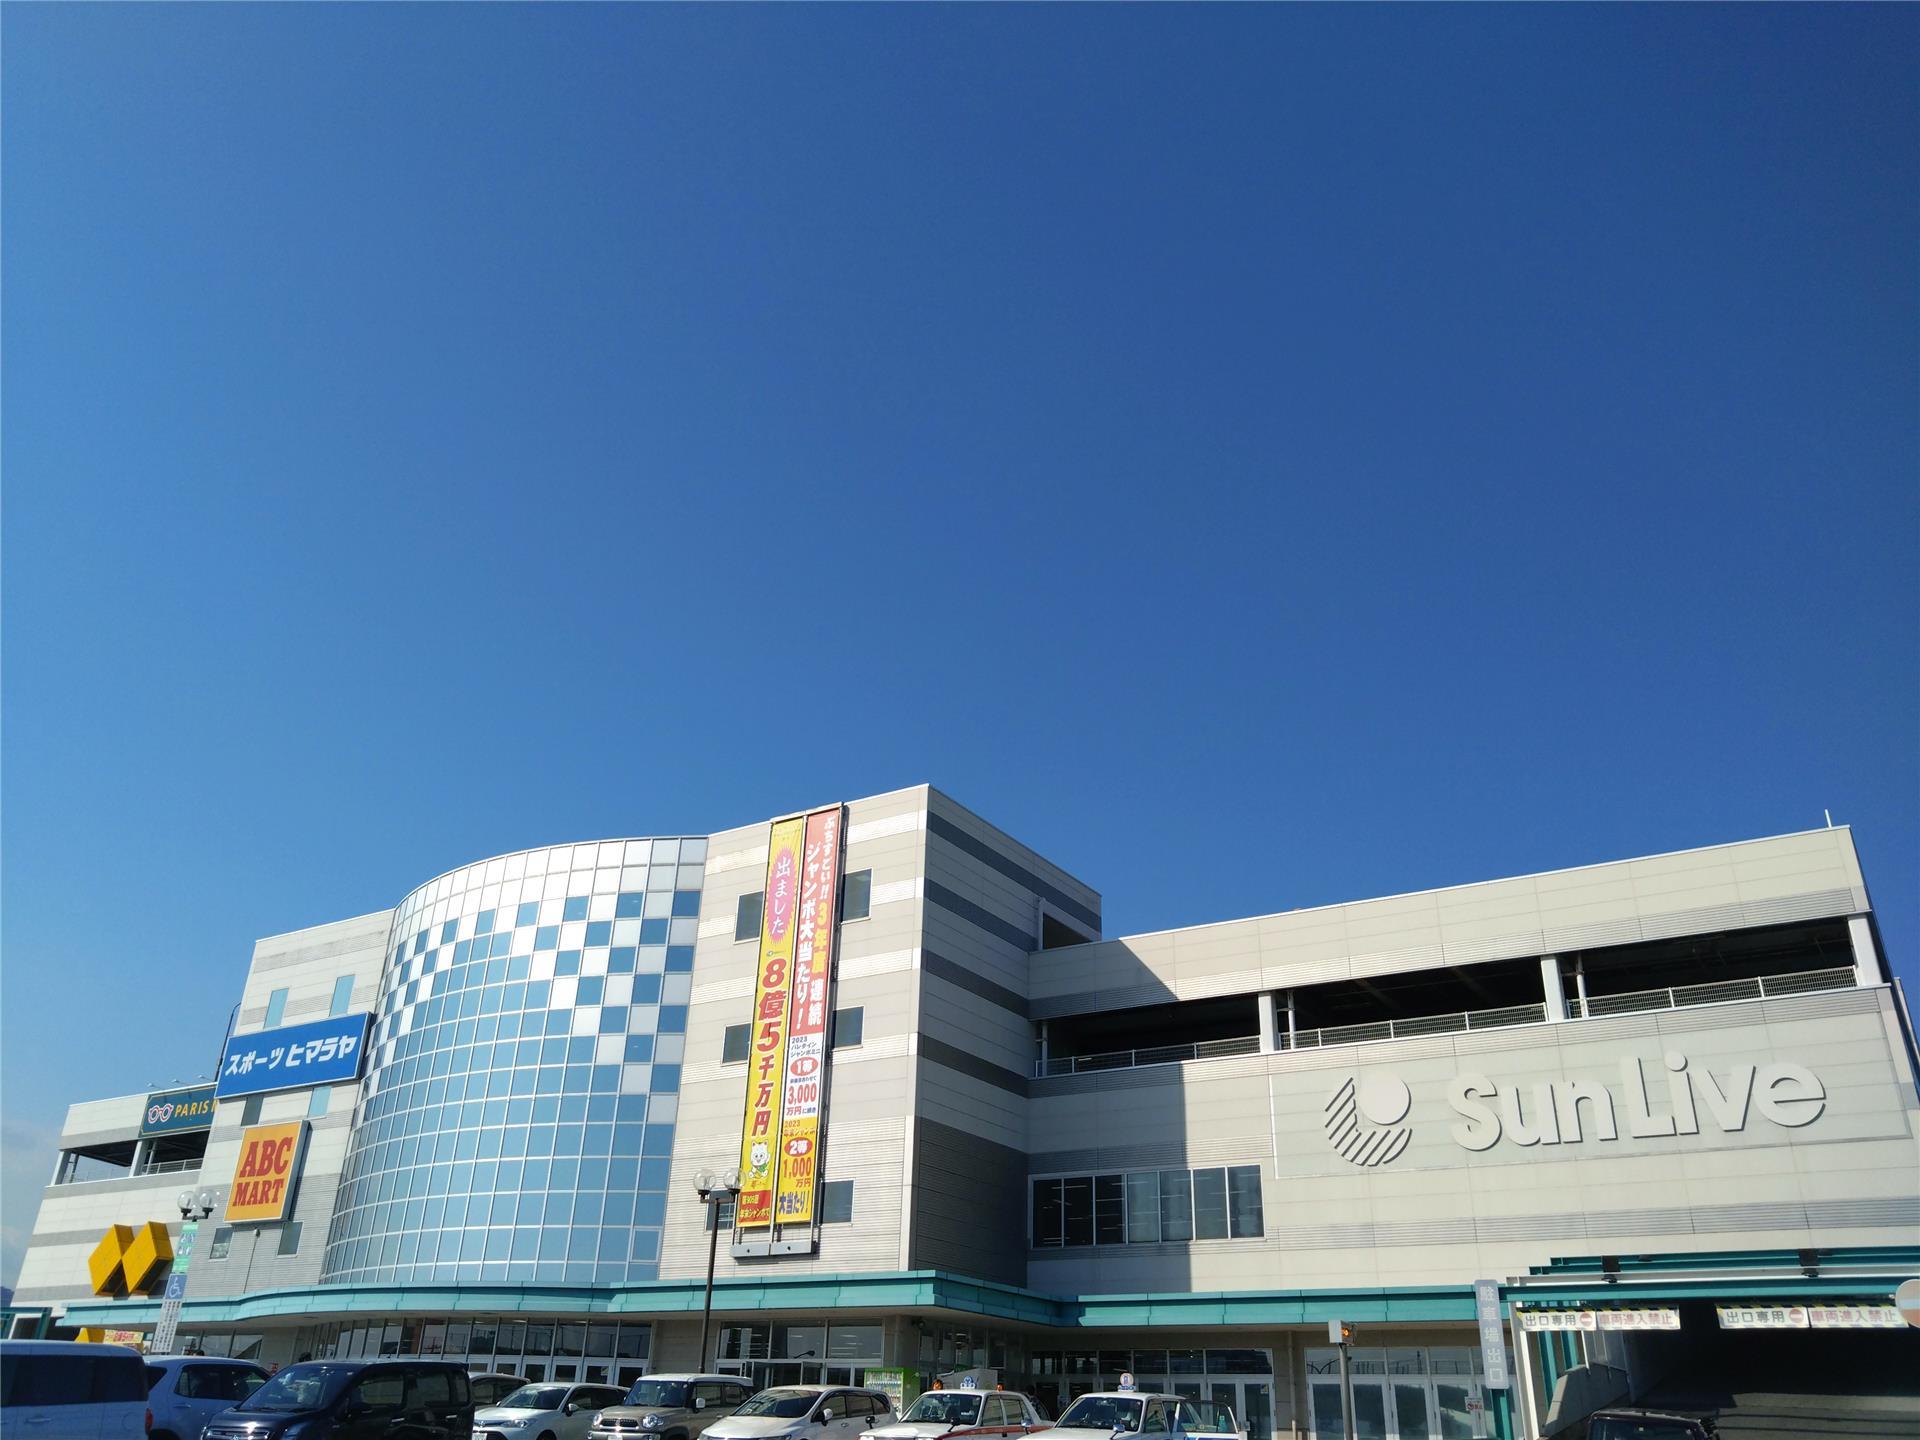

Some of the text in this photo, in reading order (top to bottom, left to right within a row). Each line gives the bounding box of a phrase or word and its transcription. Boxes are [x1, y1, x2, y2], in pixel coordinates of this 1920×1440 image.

[771, 856, 791, 934] 出ました
[752, 958, 787, 1136] 8億5千万円
[788, 1083, 817, 1105] 3,000
[1448, 1050, 1826, 1151] SunLive
[175, 1100, 209, 1118] PARIS
[239, 1136, 294, 1178] ABC
[783, 1157, 812, 1178] 1,000
[232, 1178, 284, 1207] MART
[795, 1178, 811, 1188] 万円
[778, 1190, 810, 1215] 大当たり!
[1525, 1313, 1577, 1327] 出口専用
[1599, 1310, 1674, 1326] 車両進入禁止
[1726, 1310, 1785, 1323] 出口専用
[1811, 1309, 1898, 1323] 車両進入禁止
[1480, 1286, 1504, 1381] 駐車場出口
